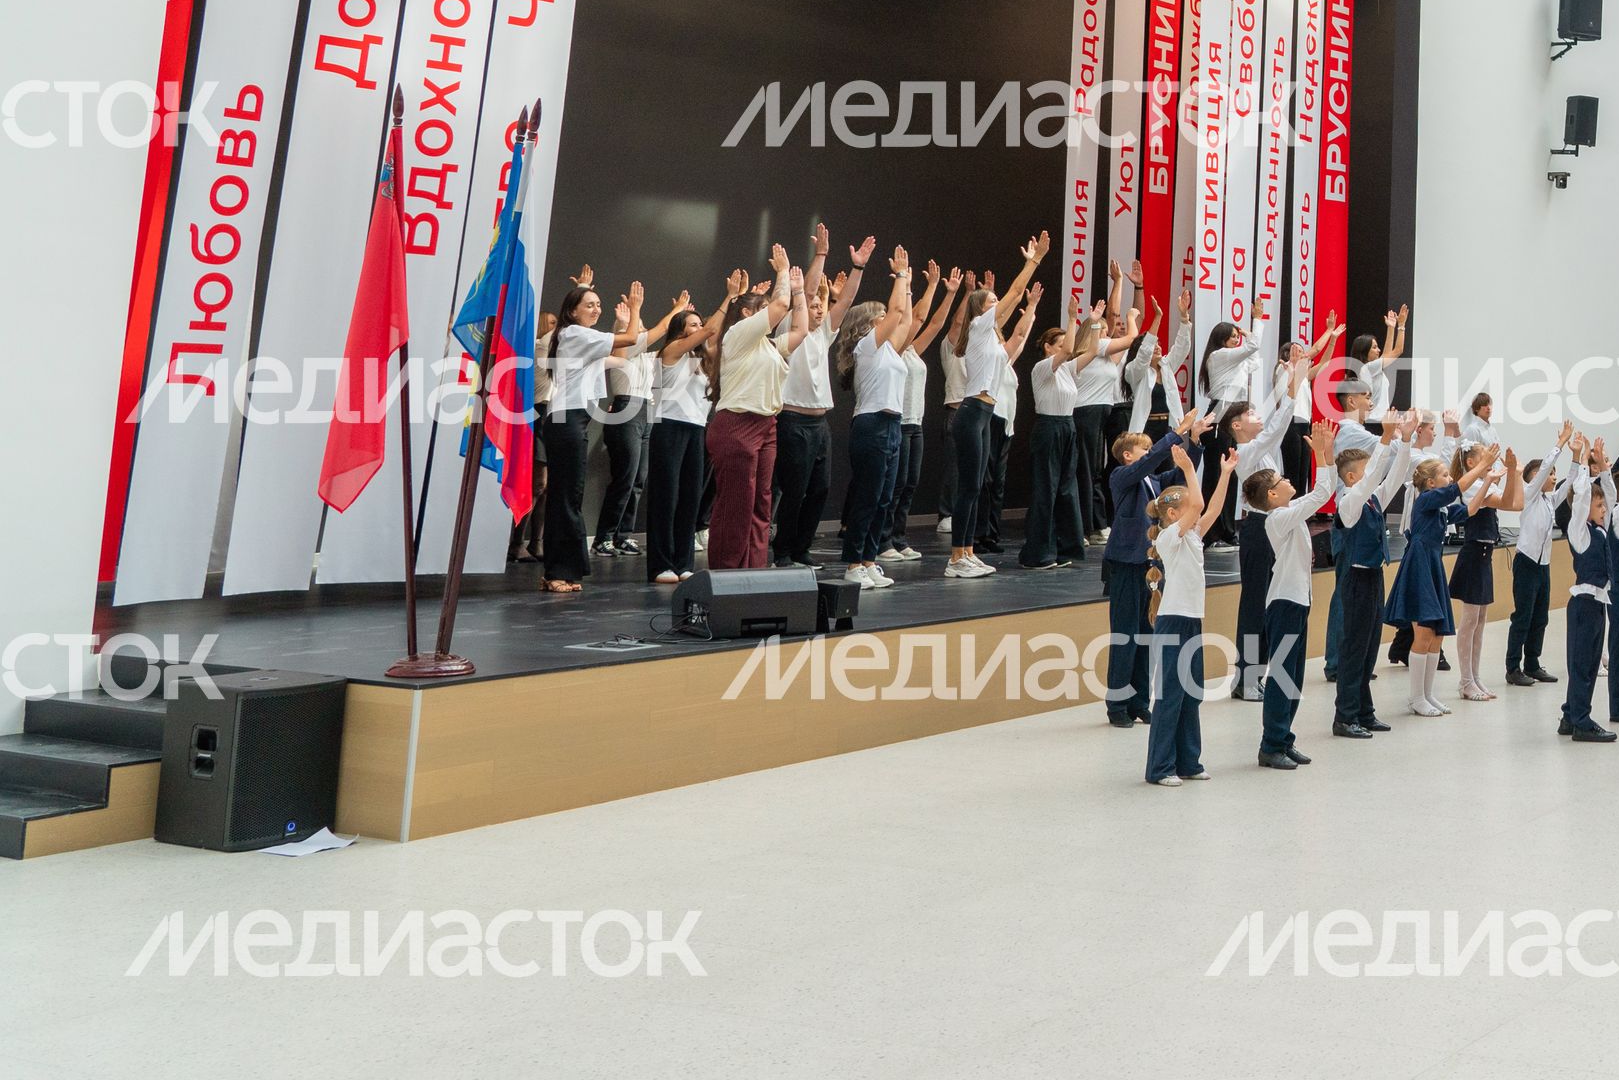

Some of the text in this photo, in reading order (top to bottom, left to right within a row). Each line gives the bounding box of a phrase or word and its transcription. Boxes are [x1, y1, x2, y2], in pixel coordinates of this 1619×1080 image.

[166, 83, 265, 398] Любовь
[1114, 138, 1136, 218] Уют
[1199, 41, 1223, 291] Мотивация
[1298, 192, 1311, 346] дрость
